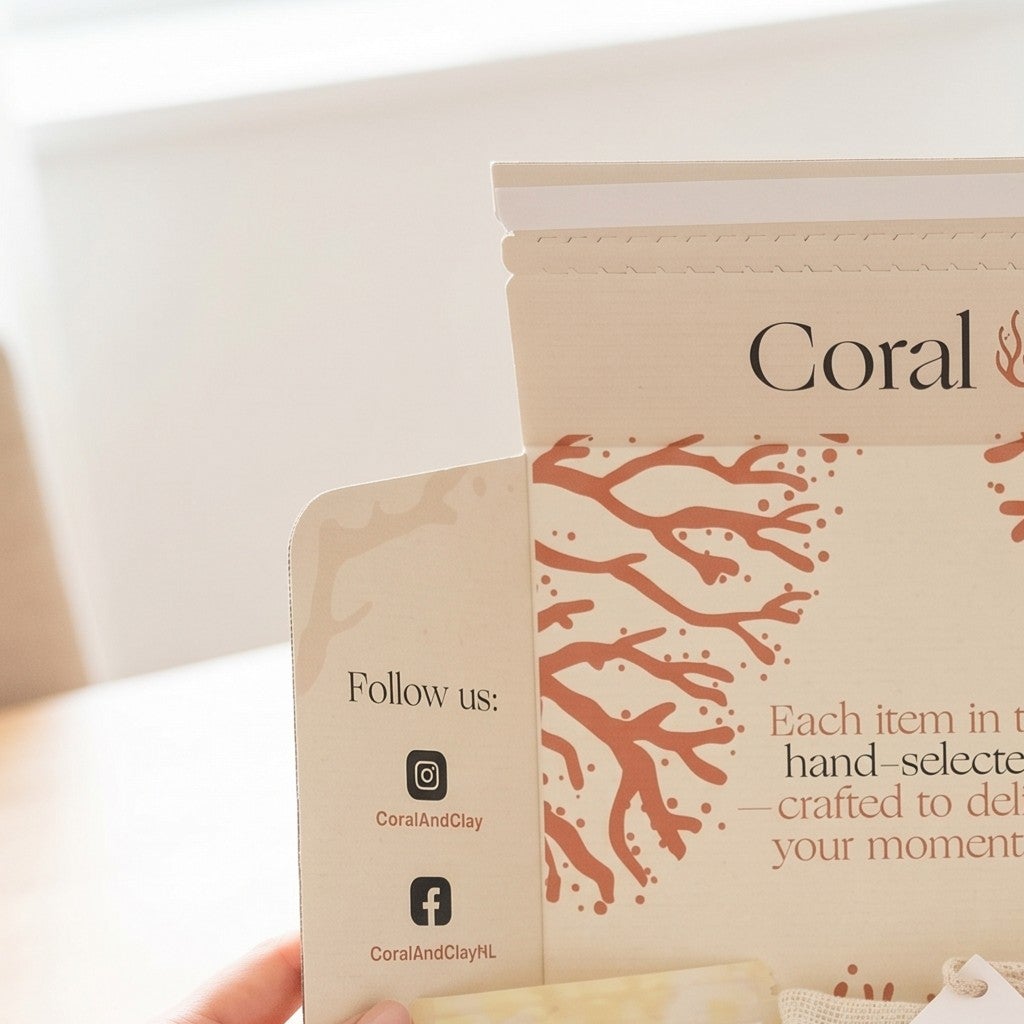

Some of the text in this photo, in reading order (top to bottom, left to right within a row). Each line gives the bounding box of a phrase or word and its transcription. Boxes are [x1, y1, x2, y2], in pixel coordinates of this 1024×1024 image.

[749, 309, 977, 392] Coral
[347, 670, 498, 712] Follow us:
[770, 700, 863, 737] Each
[875, 704, 955, 735] item
[968, 702, 1000, 734] in
[375, 810, 483, 832] CoralAndClay
[916, 791, 953, 818] to
[771, 837, 855, 870] your
[867, 832, 1024, 860] moment
